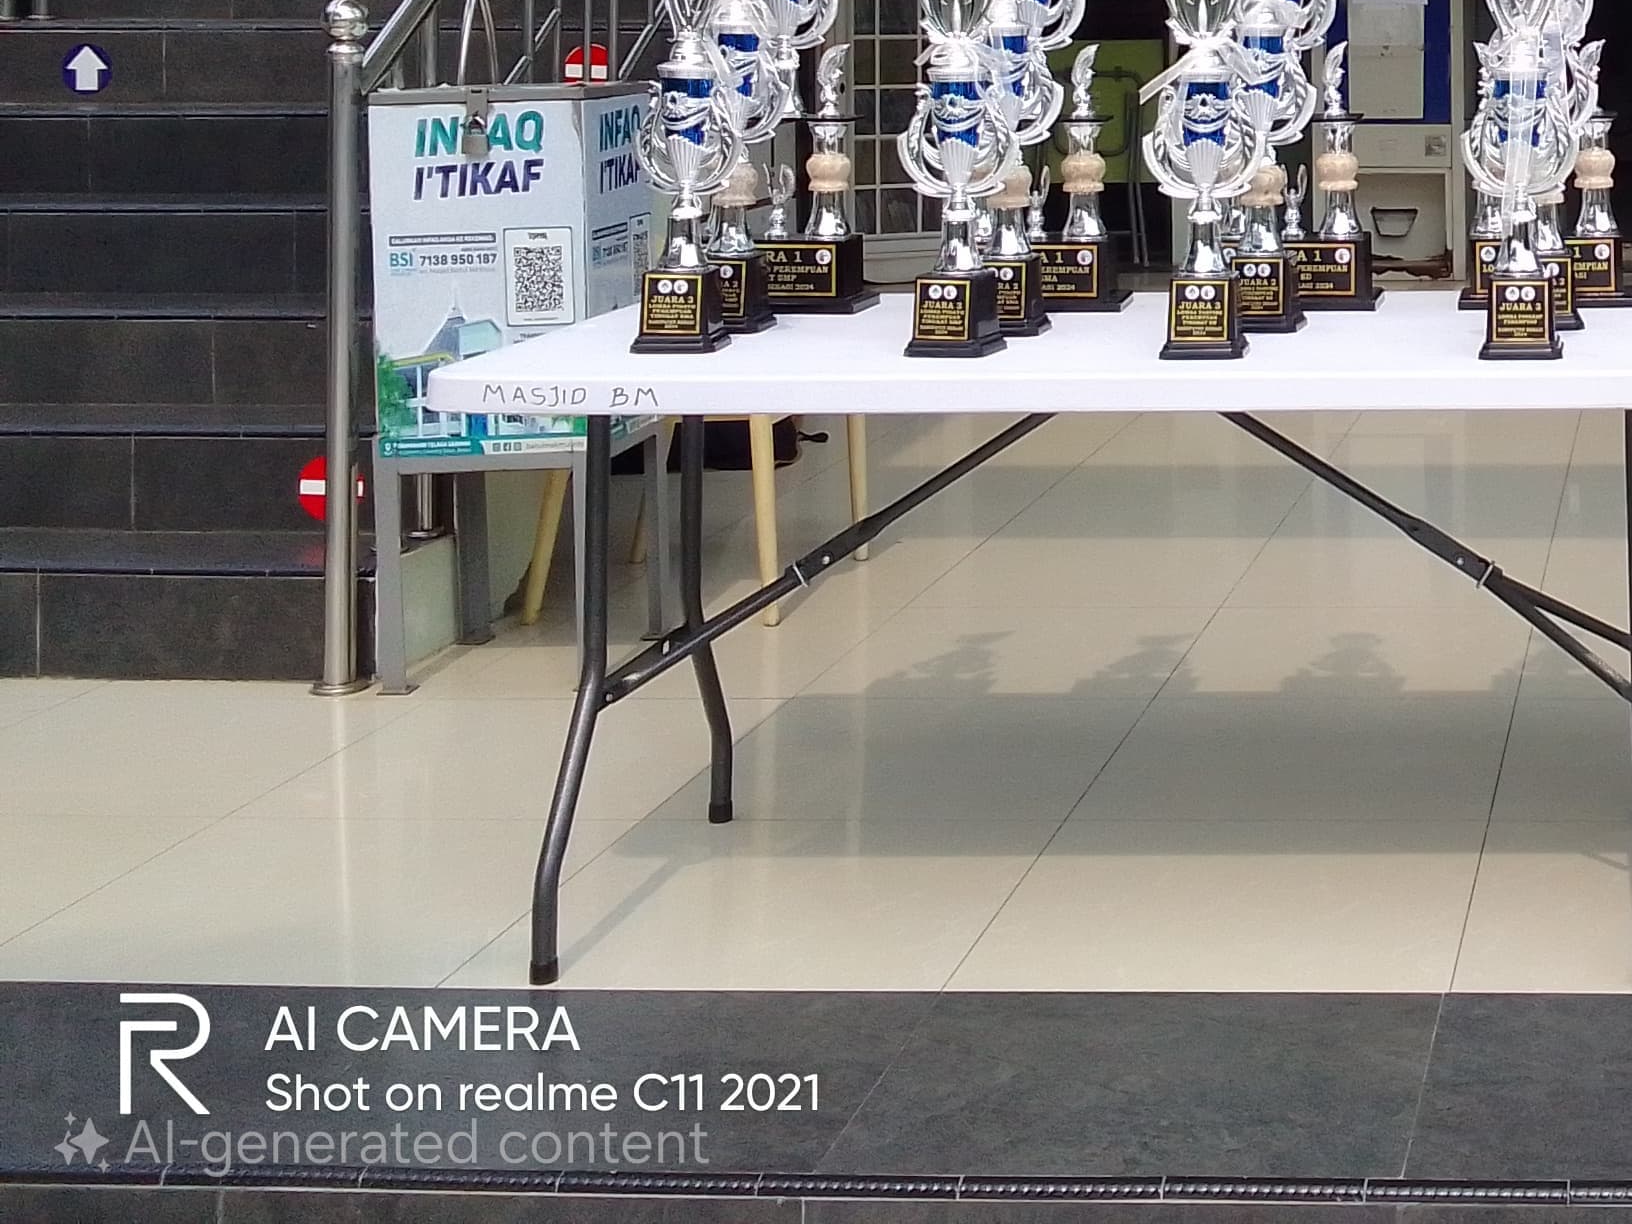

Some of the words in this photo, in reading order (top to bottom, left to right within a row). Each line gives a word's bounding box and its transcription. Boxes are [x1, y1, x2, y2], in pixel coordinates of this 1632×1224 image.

[414, 110, 544, 158] INAQ
[413, 159, 544, 201] I'TIKAF
[795, 252, 802, 262] 1
[1056, 252, 1064, 263] 1
[1314, 250, 1321, 261] 1
[1574, 247, 1581, 258] 1
[390, 253, 413, 266] BSI
[420, 255, 448, 266] 7138
[451, 254, 473, 264] 950
[476, 253, 497, 264] 187
[1499, 303, 1533, 311] JUARA
[1535, 303, 1541, 311] 3
[482, 384, 587, 407] MASJID
[609, 387, 659, 407] BM
